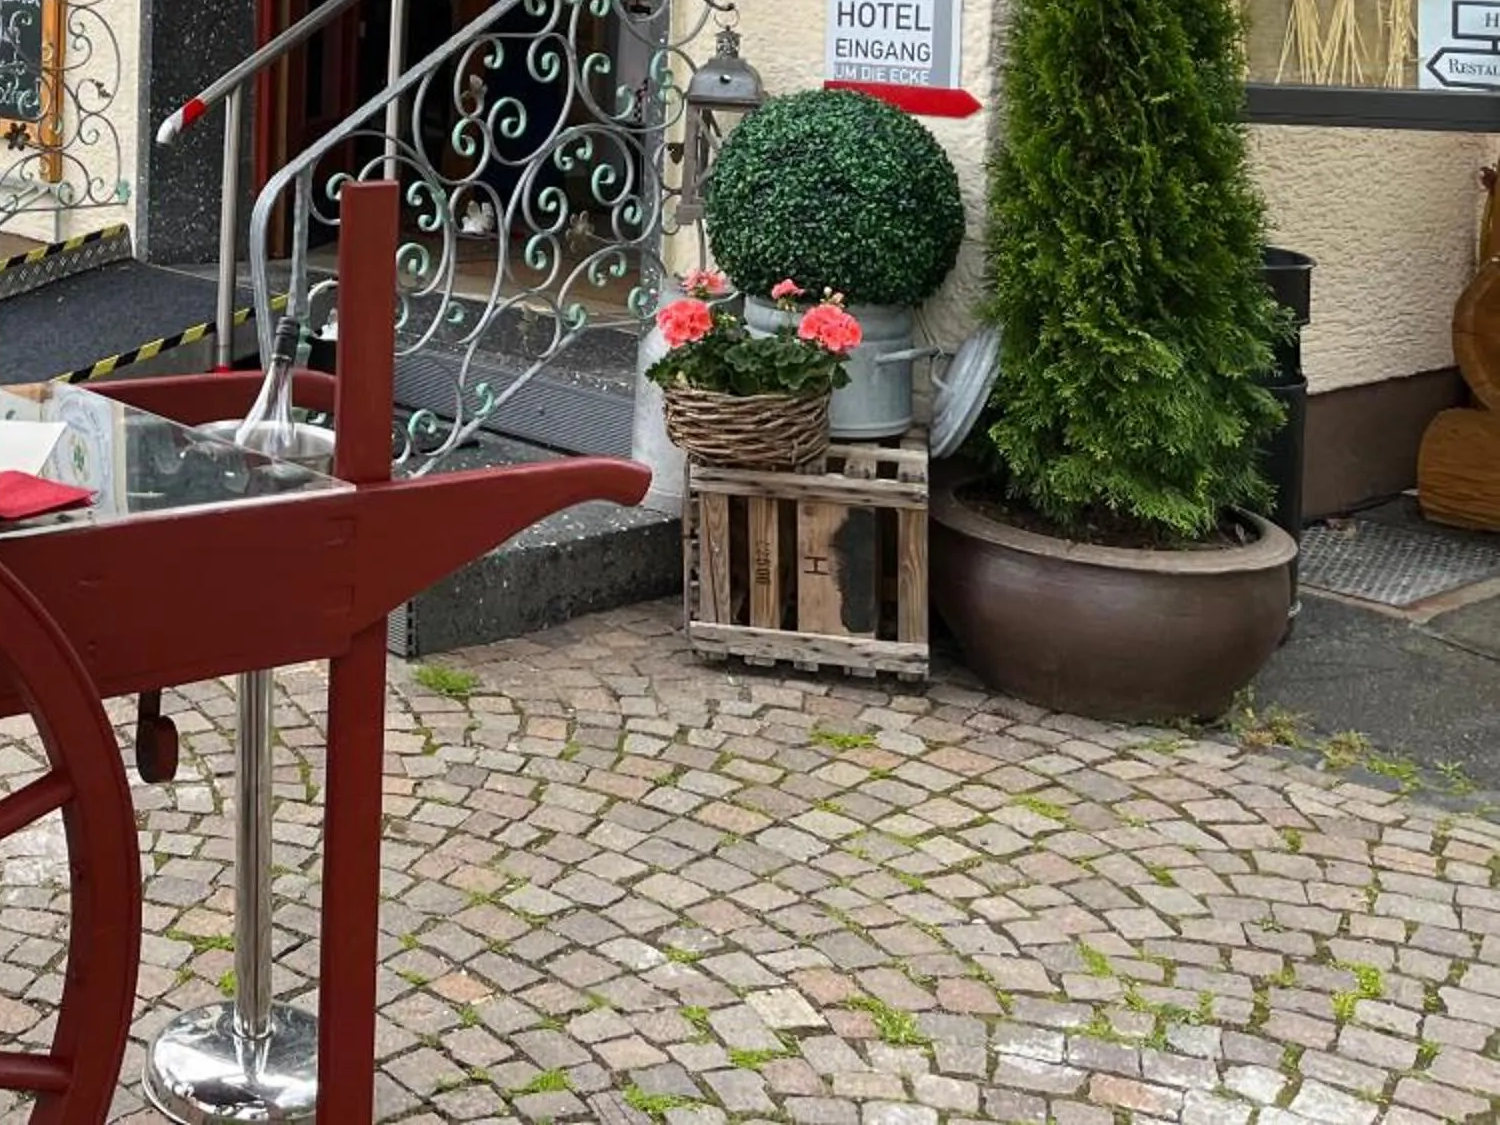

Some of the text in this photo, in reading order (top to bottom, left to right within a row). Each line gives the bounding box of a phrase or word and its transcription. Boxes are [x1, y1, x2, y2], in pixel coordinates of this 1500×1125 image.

[837, 1, 931, 32] HOTEL
[835, 38, 931, 62] EINGANG
[836, 62, 930, 86] UM DIE ECKE
